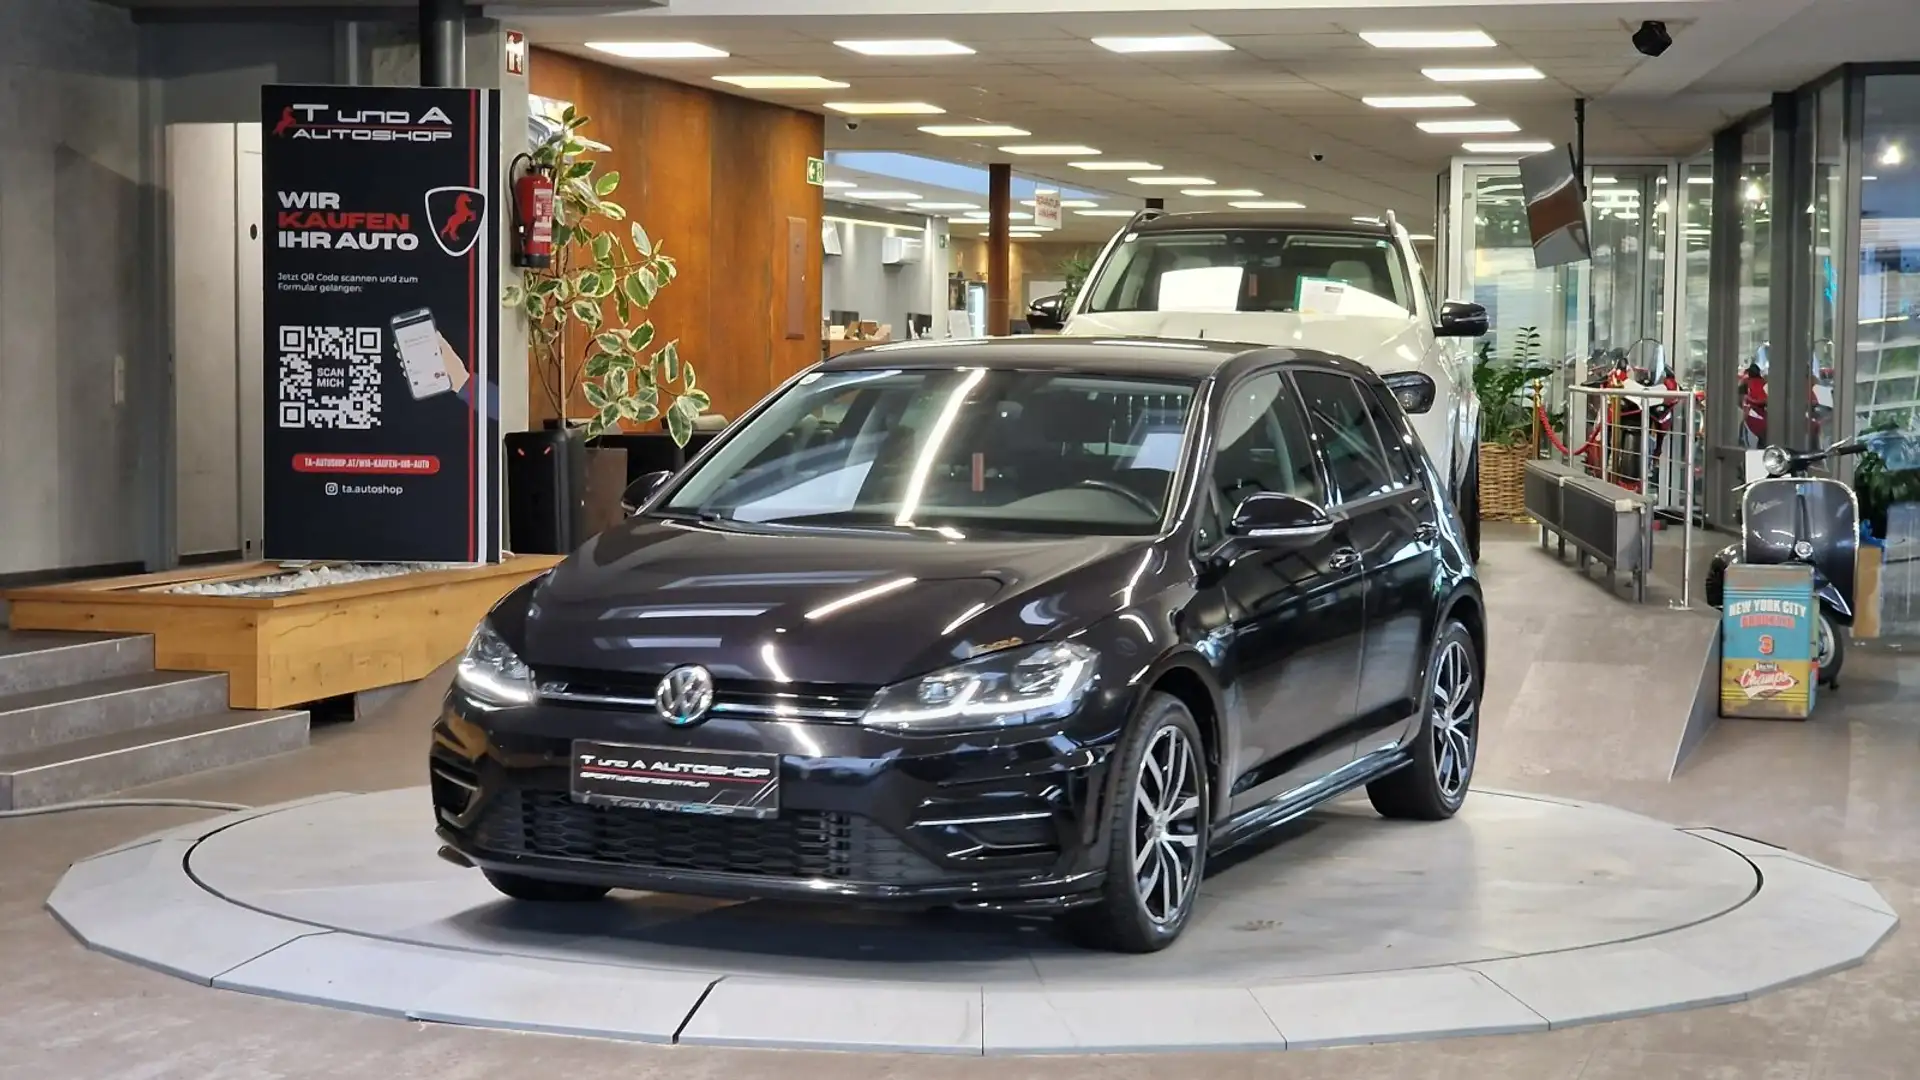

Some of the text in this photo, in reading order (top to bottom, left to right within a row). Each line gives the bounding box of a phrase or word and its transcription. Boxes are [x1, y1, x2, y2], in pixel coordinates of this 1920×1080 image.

[293, 104, 329, 122] T
[417, 106, 453, 125] A
[293, 128, 453, 142] AUTOSHOP
[277, 191, 341, 210] WIR
[278, 212, 410, 231] KAUFEN
[278, 231, 419, 251] IHR AUTO
[278, 272, 299, 281] Jetzt
[301, 273, 315, 282] QR
[316, 273, 340, 282] Code
[340, 275, 378, 283] scannen
[379, 275, 397, 283] und
[278, 282, 318, 291] Formular
[316, 367, 345, 377] SCAN
[316, 378, 345, 388] MICH
[342, 484, 404, 496] ta.autoshop
[1729, 599, 1807, 618] NEW YORK CITY
[579, 754, 596, 765] T
[631, 759, 647, 770] A
[650, 761, 771, 778] AUTOSHOP
